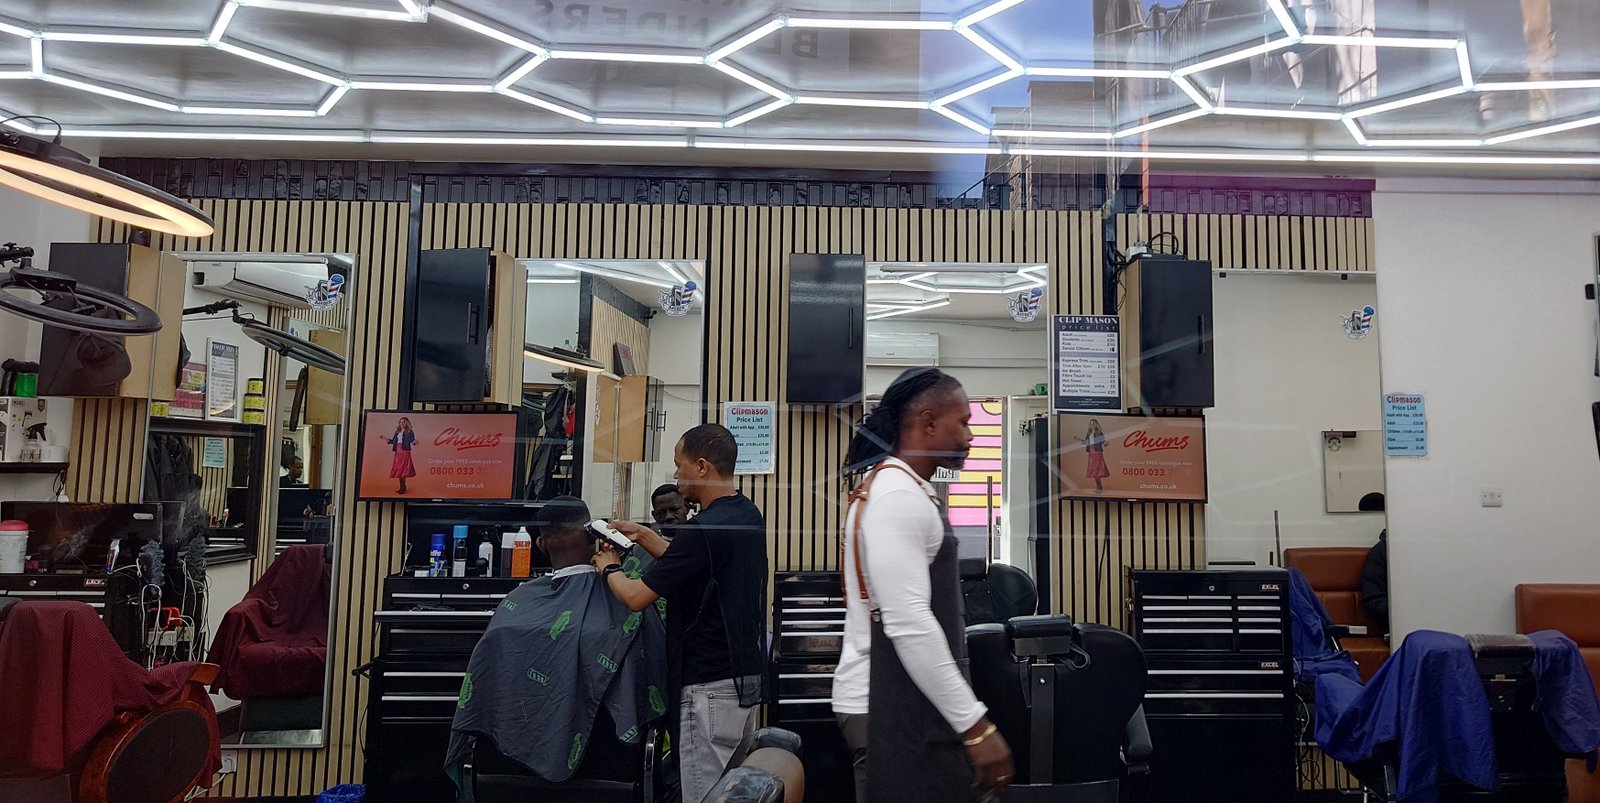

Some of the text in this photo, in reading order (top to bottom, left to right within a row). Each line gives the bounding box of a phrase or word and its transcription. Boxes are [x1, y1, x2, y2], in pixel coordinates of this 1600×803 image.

[434, 427, 503, 449] Chums
[1123, 430, 1190, 451] Chums
[430, 467, 454, 475] 0800
[457, 467, 474, 475] 033
[1122, 467, 1145, 476] 0800
[1148, 468, 1165, 476] 033
